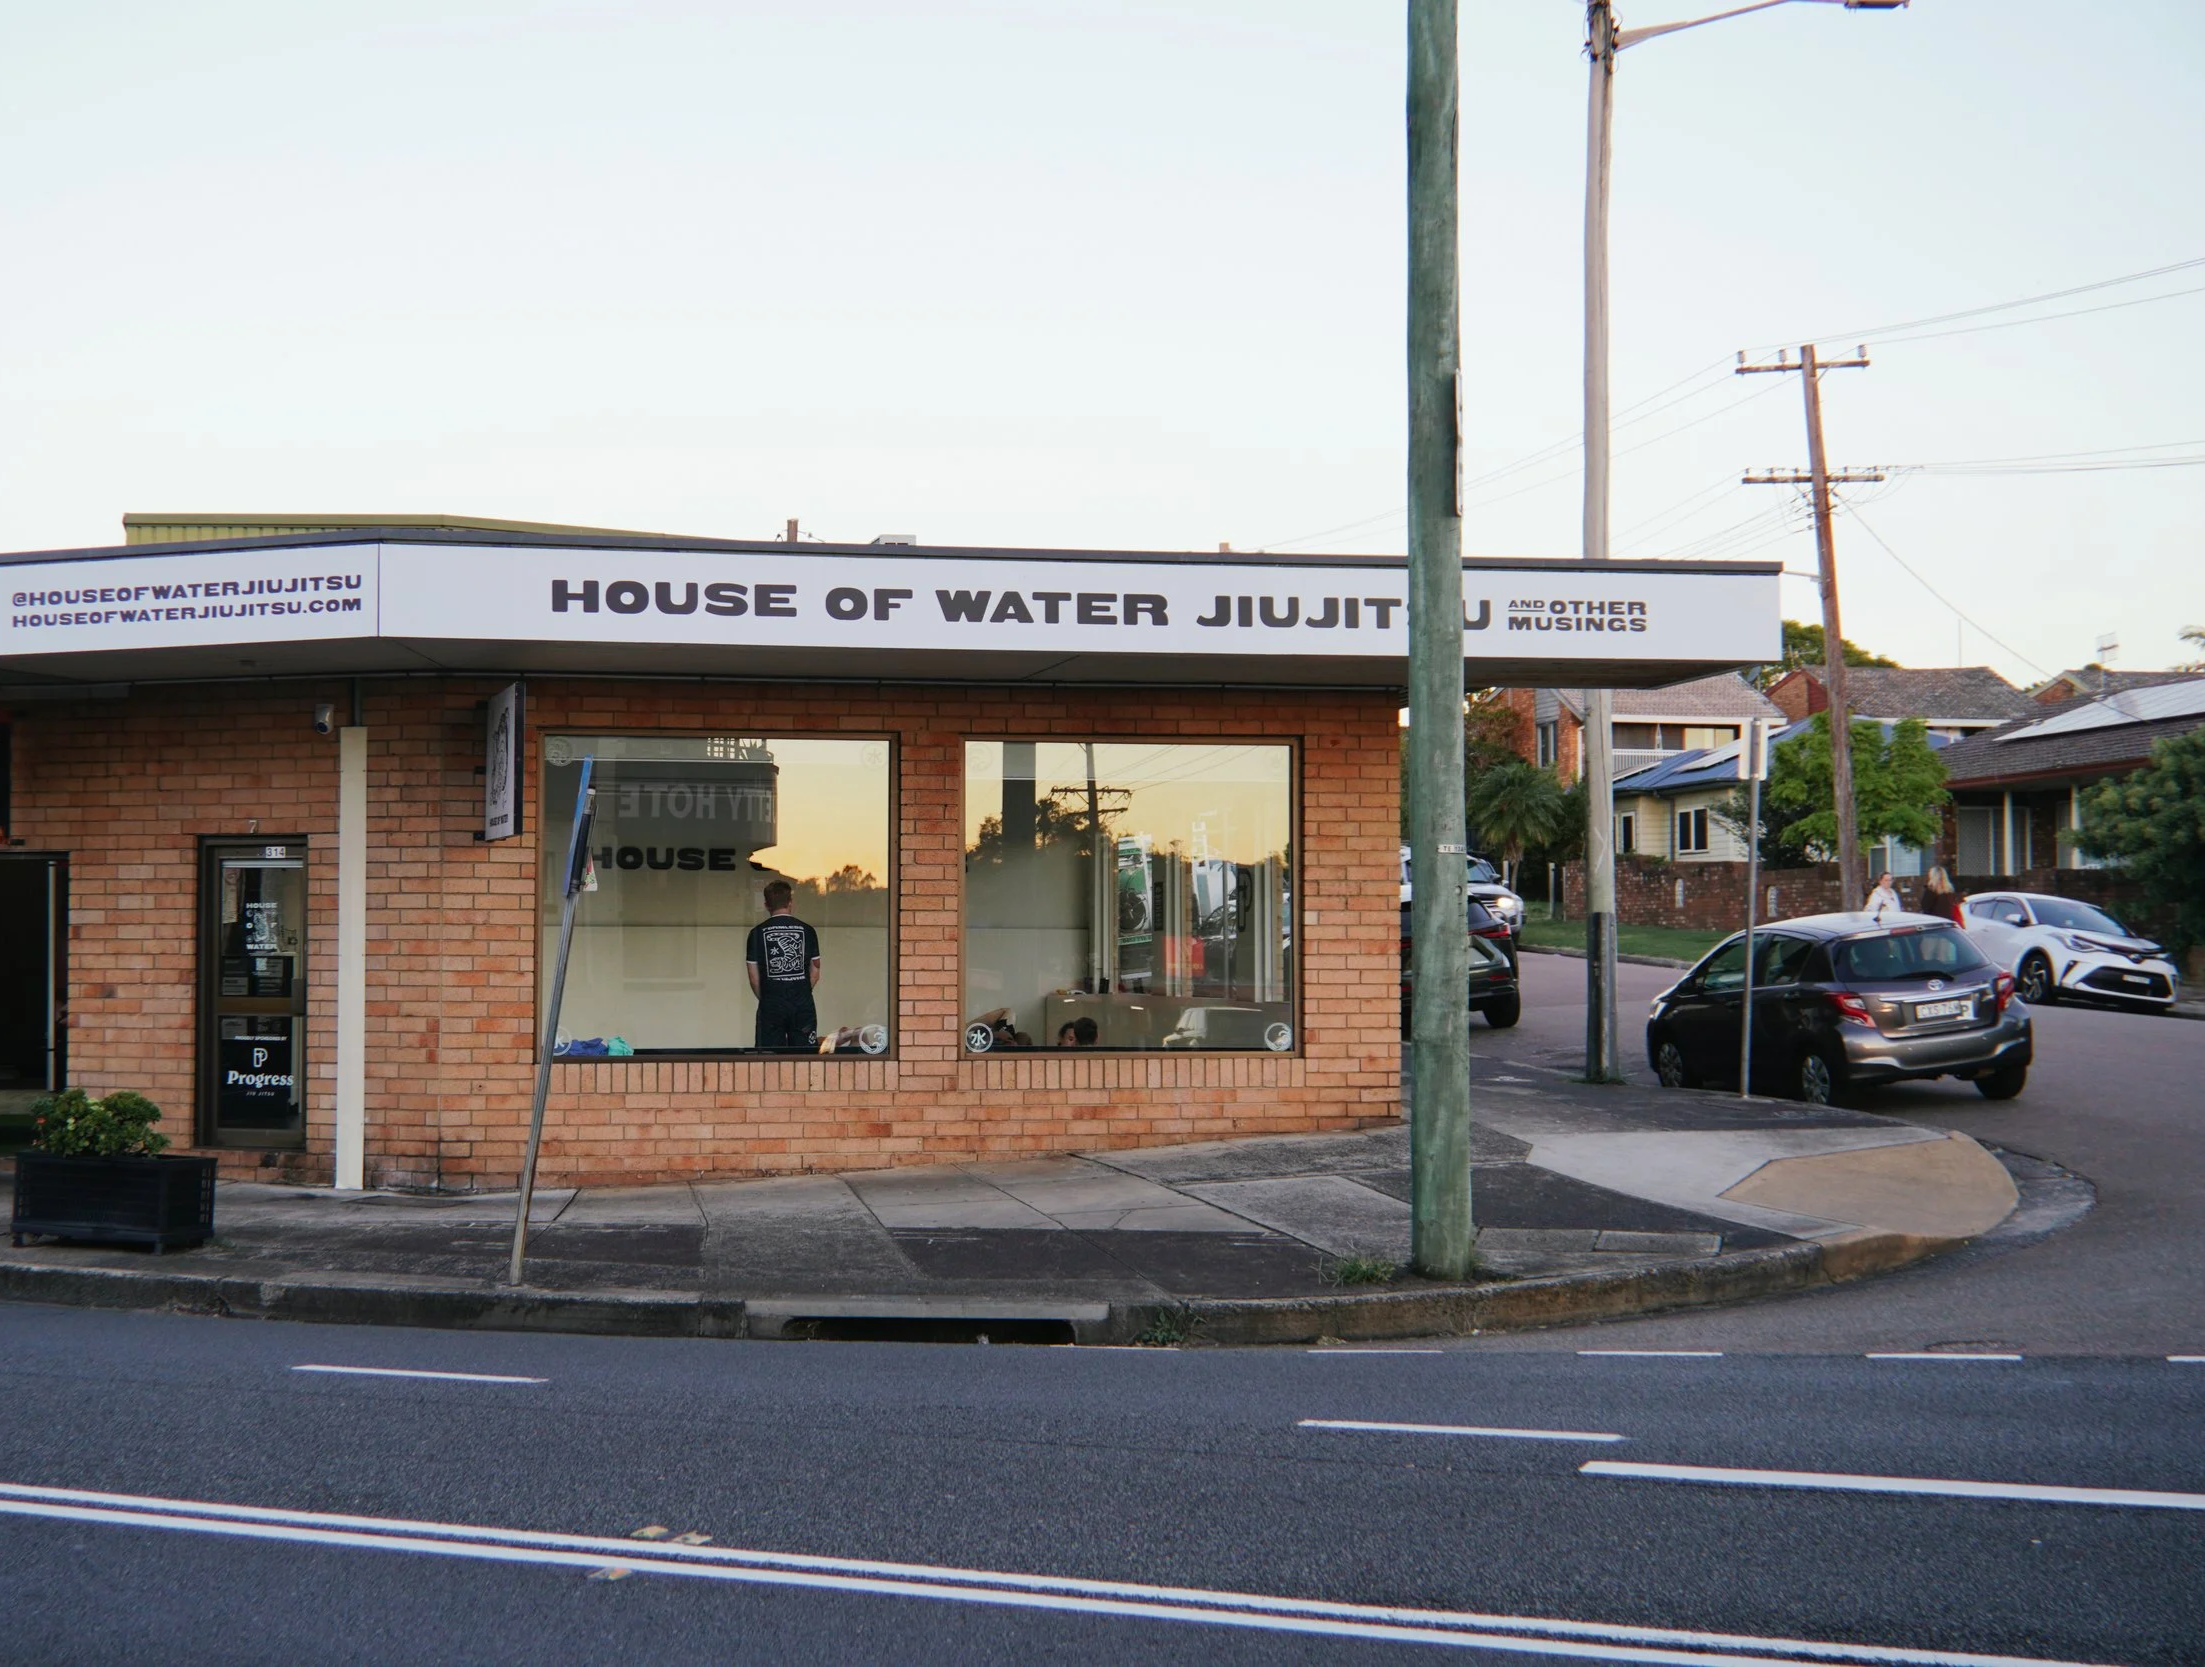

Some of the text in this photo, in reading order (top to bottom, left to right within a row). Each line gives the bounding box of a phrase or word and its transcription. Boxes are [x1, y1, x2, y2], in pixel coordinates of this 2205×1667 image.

[12, 575, 362, 607] @HOUSEOFWATERJIUJITSU
[12, 598, 362, 628] HOUSEOFWATERJIUJITSU.COM
[551, 579, 1491, 630] HOUSE OF WATER JIUJITU
[1508, 599, 1647, 615] AND OTHER
[1508, 616, 1648, 632] MUSINGS
[249, 820, 257, 833] 7
[267, 847, 285, 857] 314
[970, 1029, 987, 1046] 水
[226, 1070, 295, 1089] Progress
